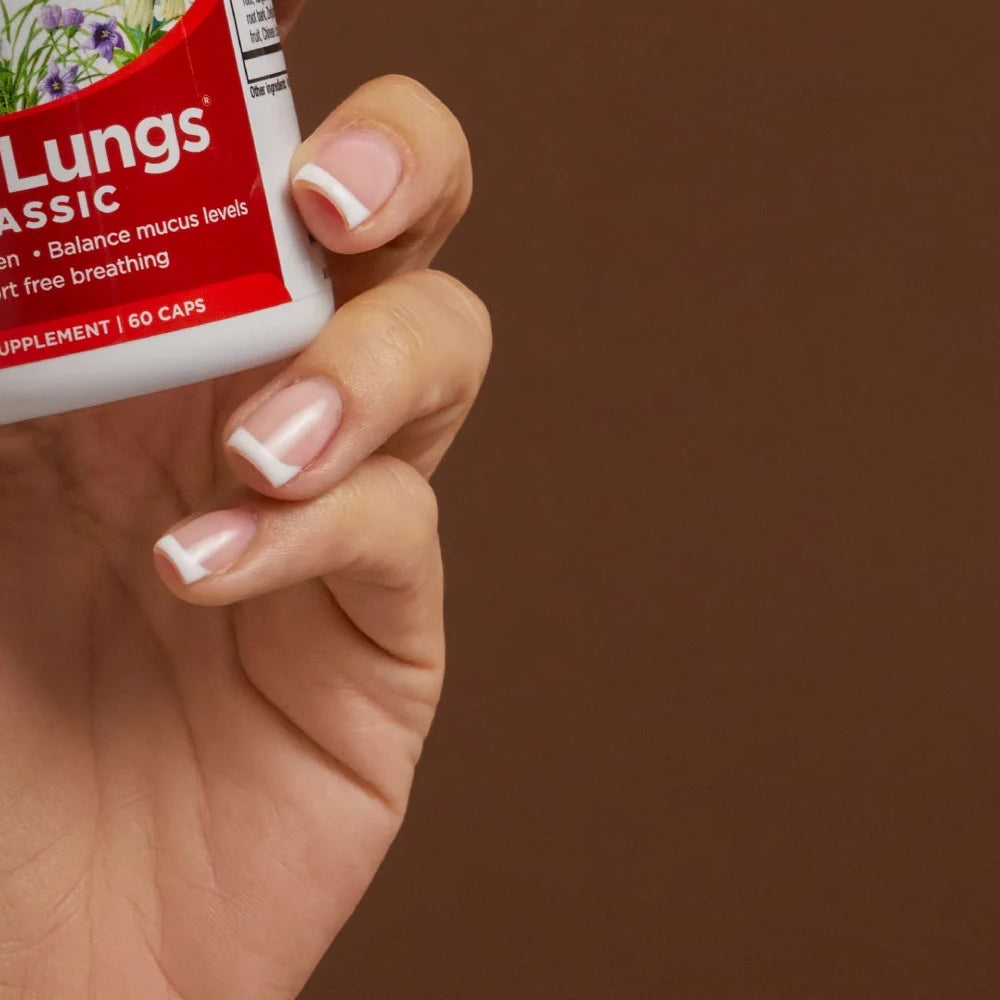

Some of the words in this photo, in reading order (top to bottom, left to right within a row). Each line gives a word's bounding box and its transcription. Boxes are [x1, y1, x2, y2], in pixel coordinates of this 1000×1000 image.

[250, 83, 265, 98] Other
[48, 229, 131, 260] Balance
[136, 213, 200, 241] mucus
[202, 199, 249, 225] levels
[23, 275, 66, 296] free
[70, 251, 170, 286] breathing
[128, 311, 153, 328] 60
[158, 298, 207, 321] CAPS
